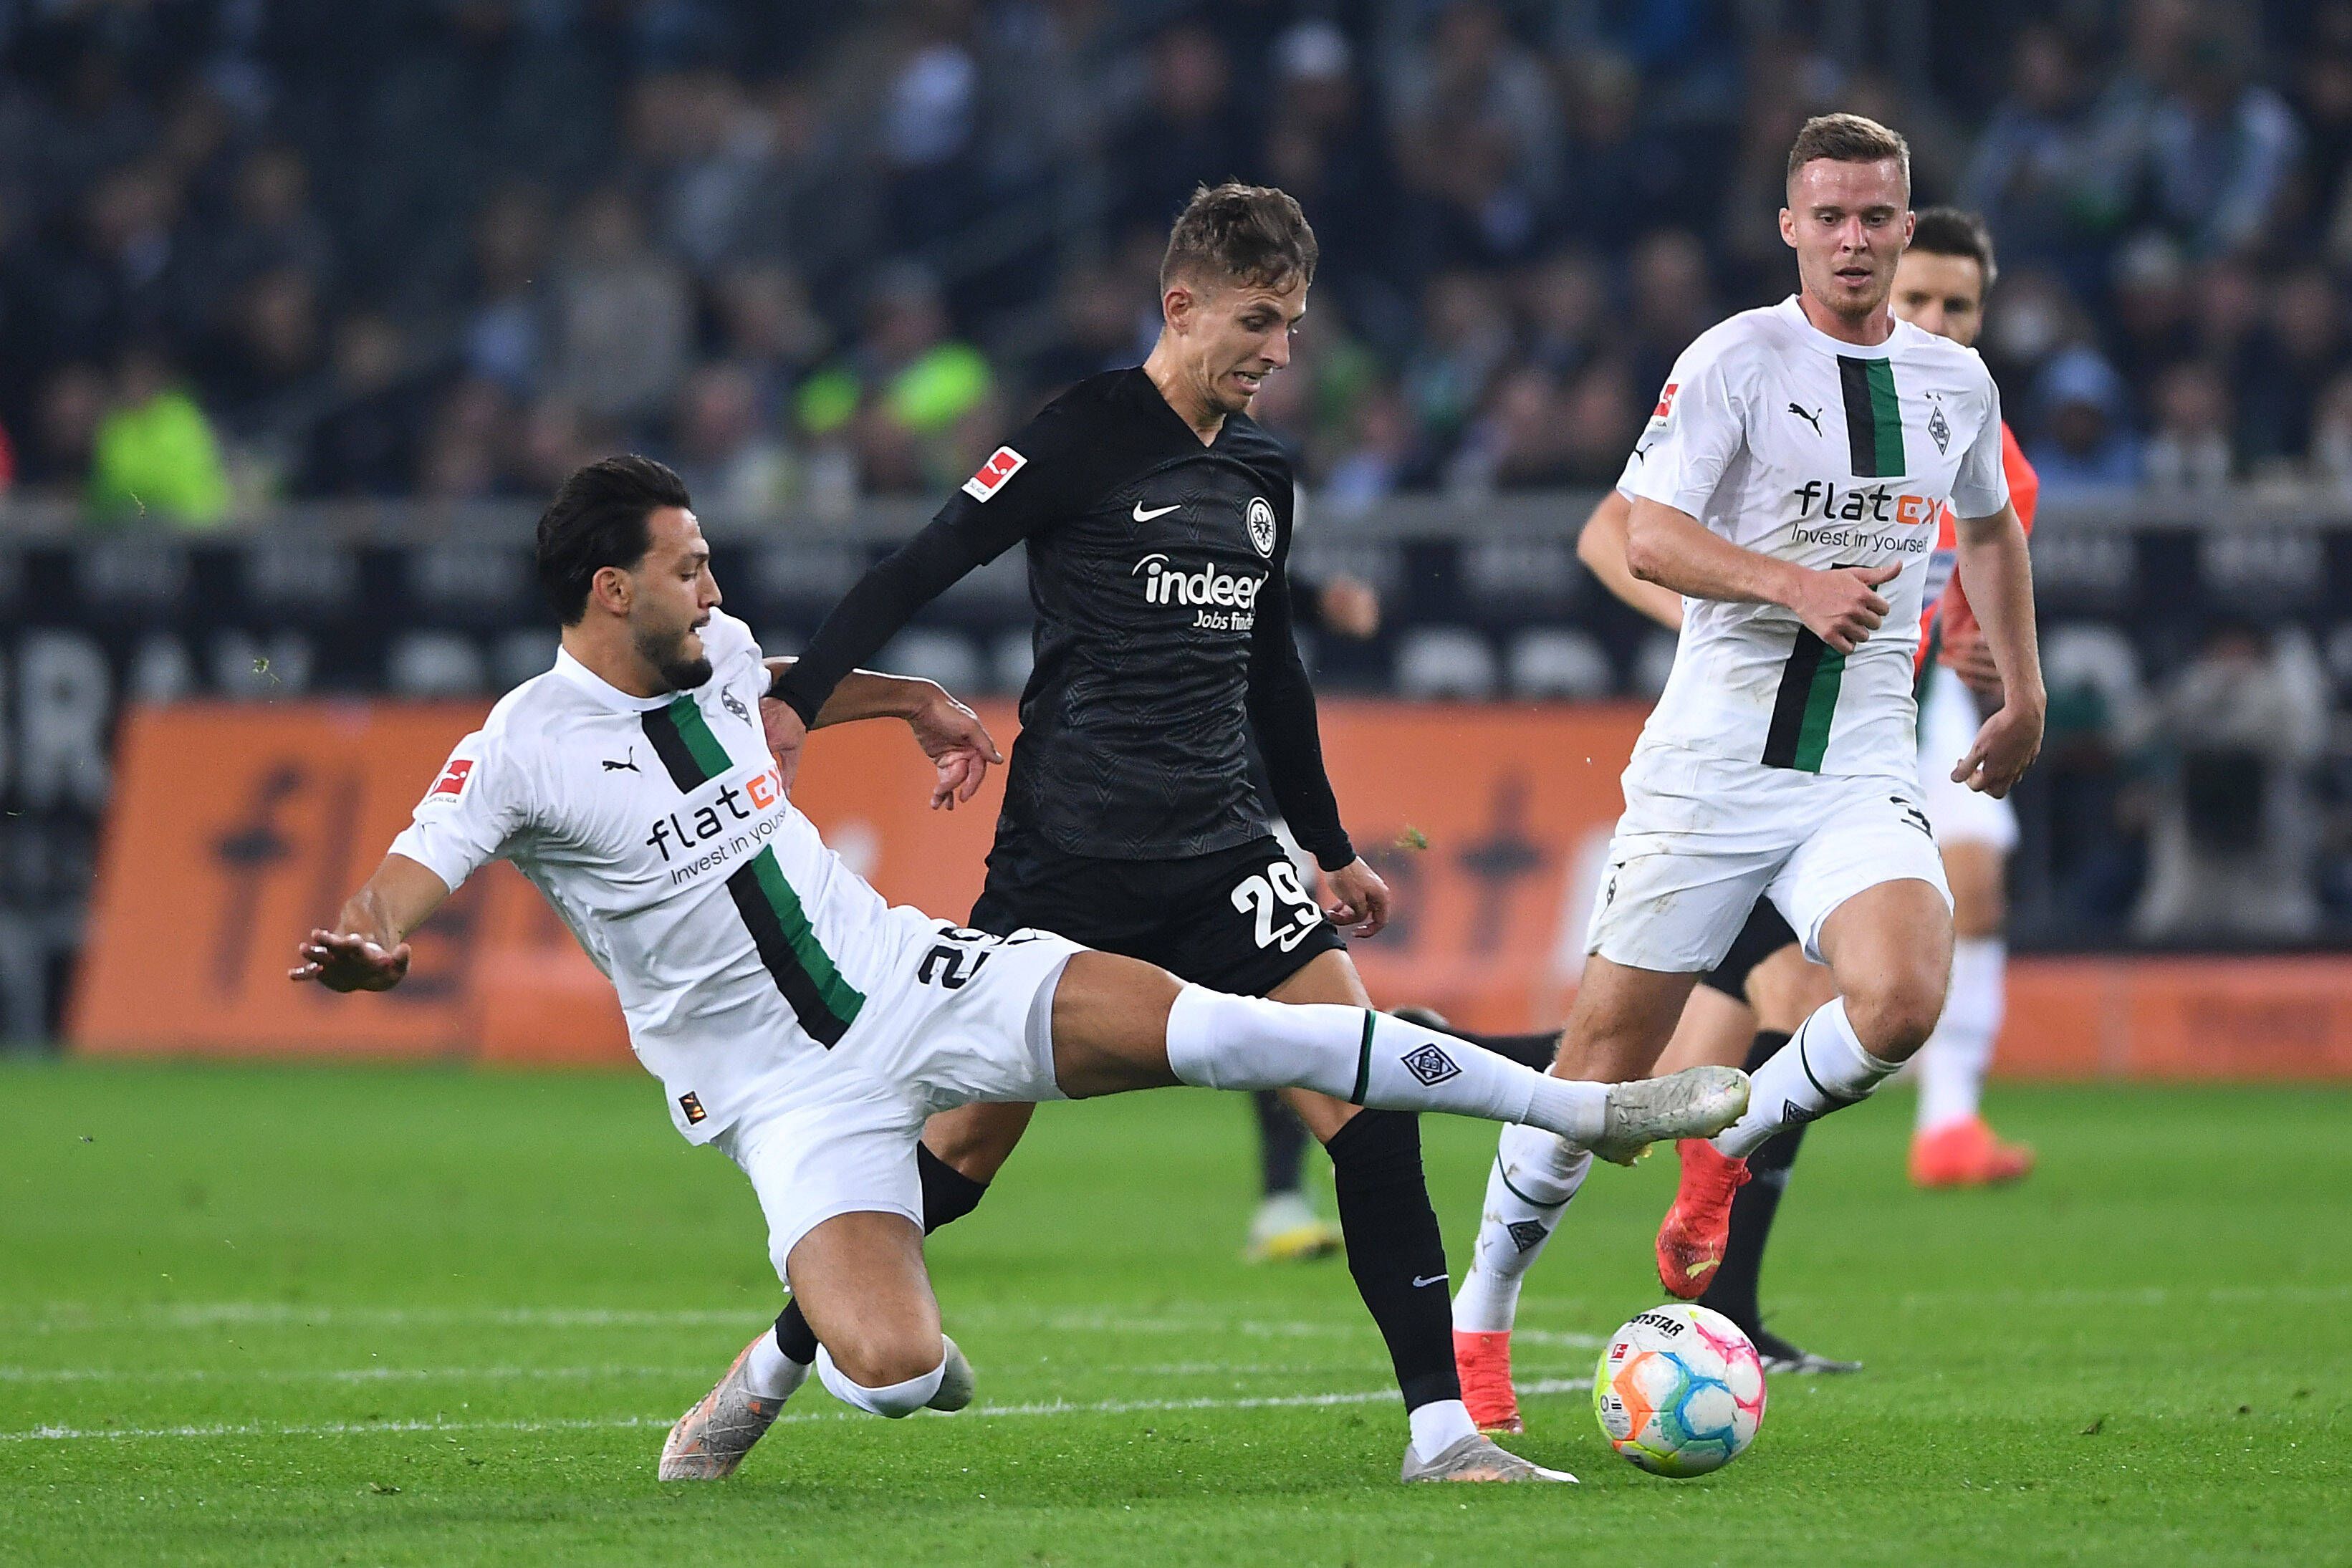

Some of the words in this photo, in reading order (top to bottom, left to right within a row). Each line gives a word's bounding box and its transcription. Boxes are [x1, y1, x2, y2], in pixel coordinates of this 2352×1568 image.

[1793, 480, 1943, 525] flatex
[1791, 523, 1850, 547] Invest
[1854, 530, 1868, 547] in
[1192, 610, 1229, 630] Jobs
[671, 845, 729, 885] Invest
[731, 837, 749, 855] in
[1230, 861, 1323, 949] 29
